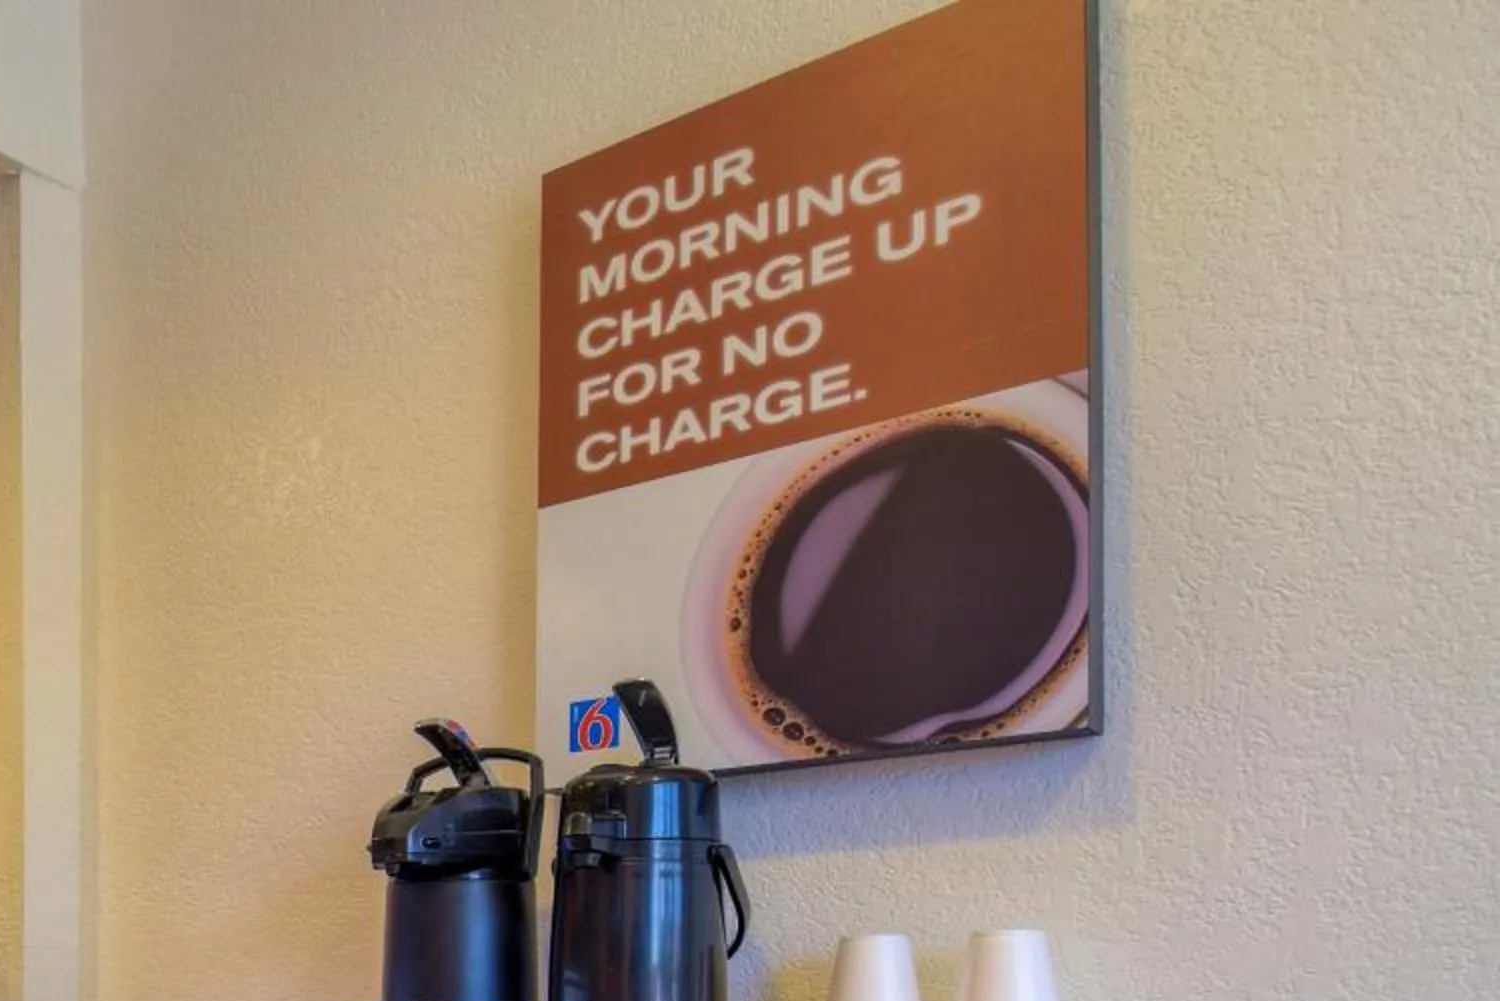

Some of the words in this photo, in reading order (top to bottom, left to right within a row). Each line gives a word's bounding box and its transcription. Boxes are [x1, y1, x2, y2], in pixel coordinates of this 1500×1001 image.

[578, 147, 755, 242] YOUR
[578, 155, 904, 303] MORNING
[577, 235, 853, 359] CHARGE
[876, 194, 982, 262] UP
[576, 348, 702, 418] FOR
[722, 311, 823, 375] NO
[576, 363, 867, 474] CHARGE.
[578, 697, 613, 751] 6
